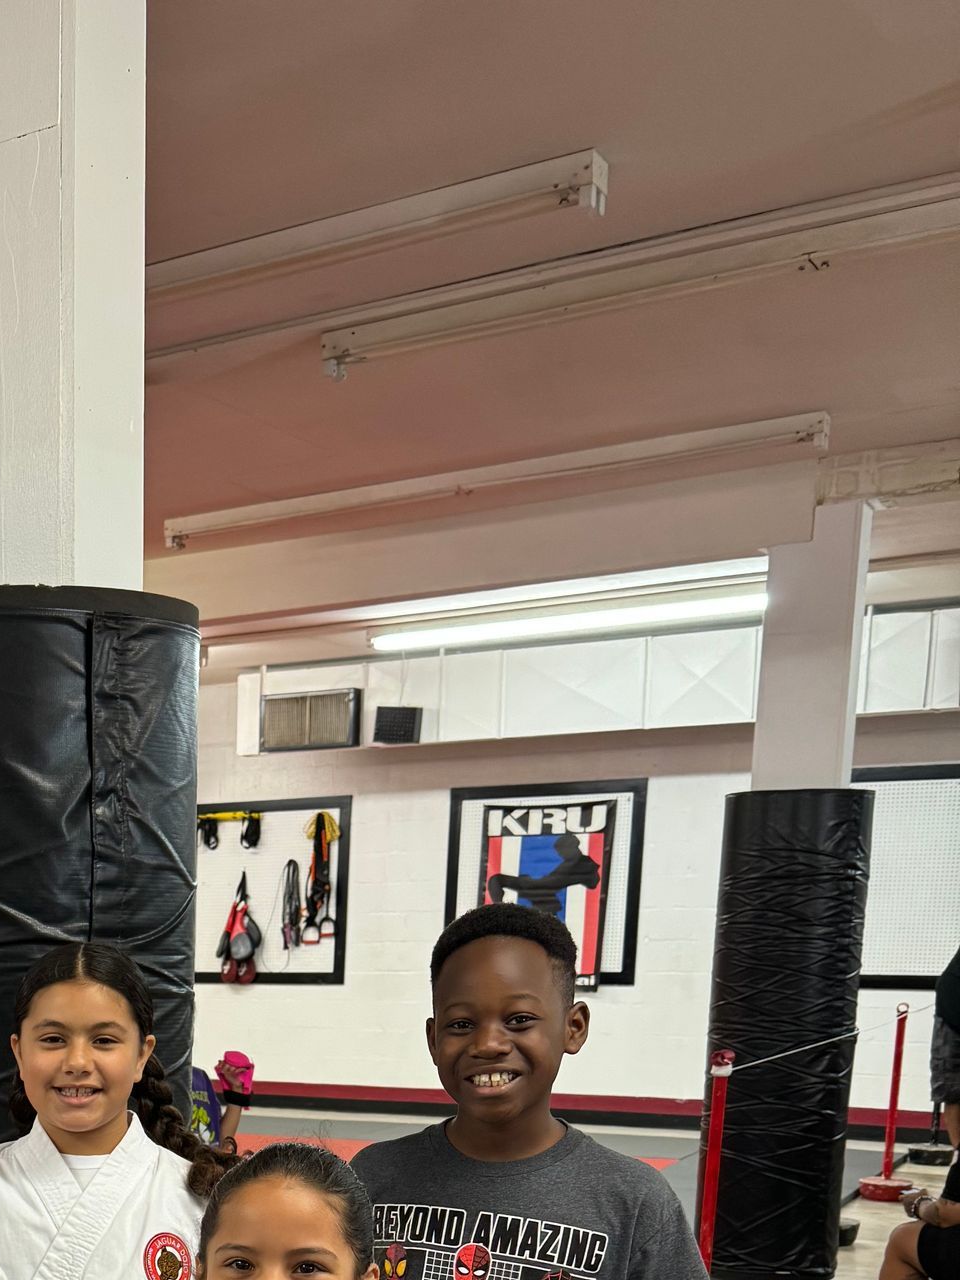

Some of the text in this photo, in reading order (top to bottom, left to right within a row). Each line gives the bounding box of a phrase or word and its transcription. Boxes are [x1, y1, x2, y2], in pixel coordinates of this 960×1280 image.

[488, 804, 607, 836] KRU
[154, 1237, 189, 1273] JAGUAR DOJO
[373, 1204, 608, 1273] BEYOND AMAZING
